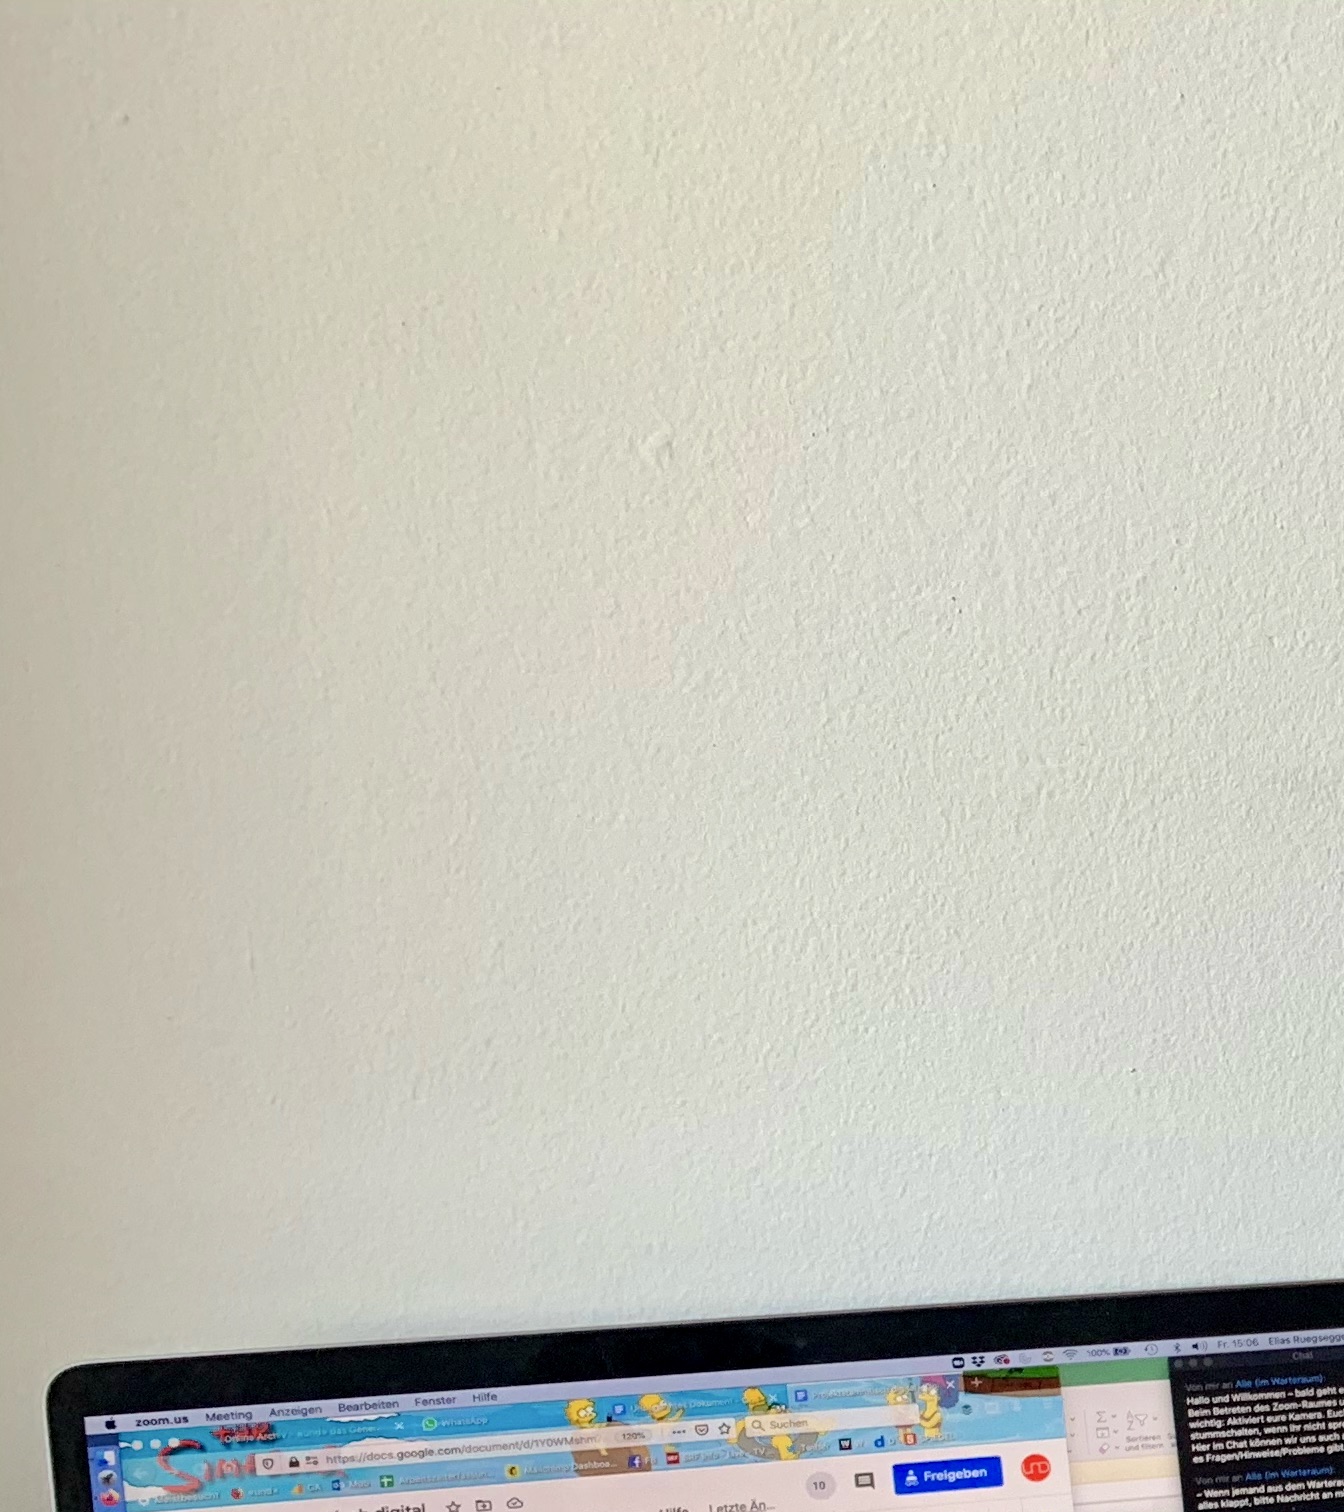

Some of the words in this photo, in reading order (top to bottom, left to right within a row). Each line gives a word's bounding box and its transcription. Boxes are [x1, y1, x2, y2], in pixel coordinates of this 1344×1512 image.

[135, 1416, 190, 1427] zoom.us
[205, 1411, 253, 1422] Meeting
[268, 1406, 323, 1418] Anzeigen
[337, 1400, 400, 1415] Bearbeiten
[414, 1396, 457, 1407] Fenster
[472, 1392, 498, 1403] Hilfe
[923, 1468, 988, 1483] Freigeben
